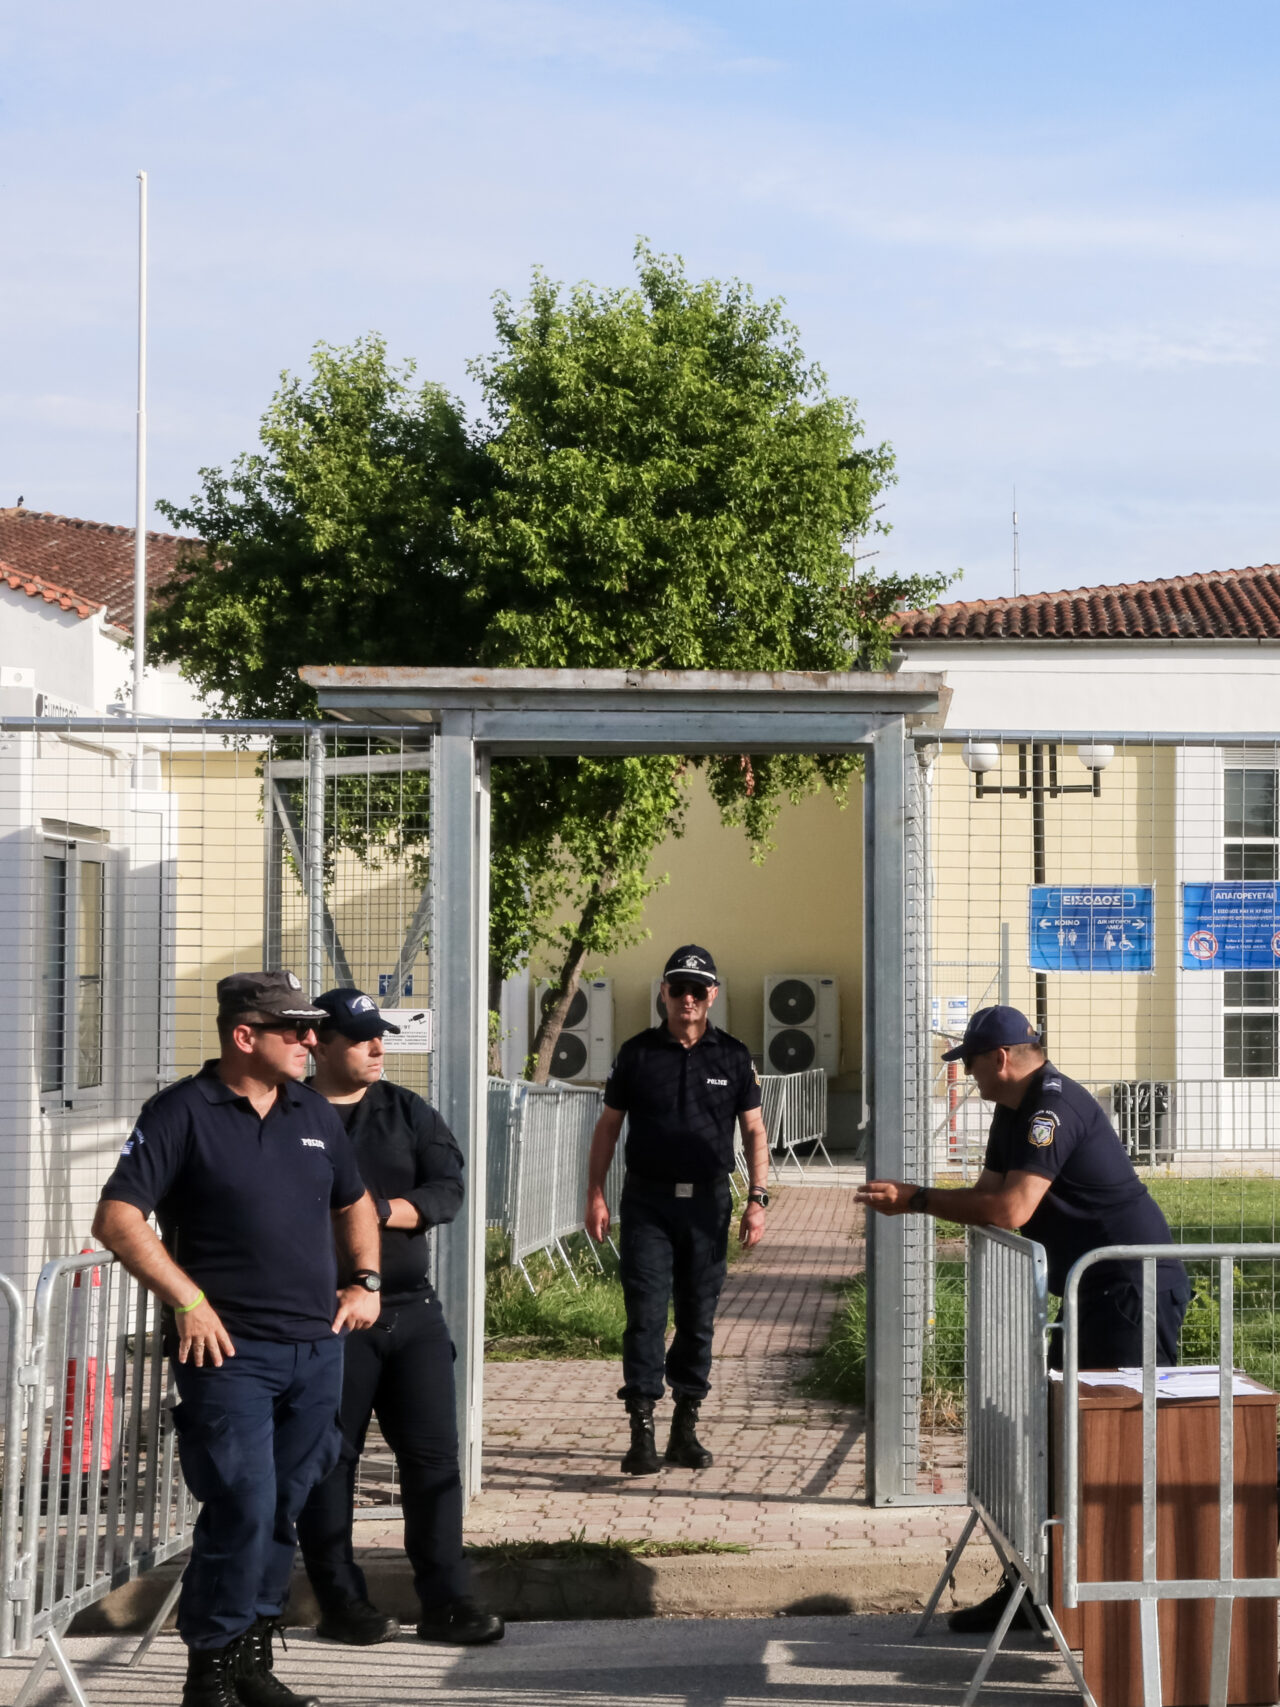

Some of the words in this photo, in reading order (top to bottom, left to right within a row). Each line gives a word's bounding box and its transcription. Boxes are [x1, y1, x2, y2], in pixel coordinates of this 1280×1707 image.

[1215, 892, 1274, 900] ΑΠΑΓΟΡΕΥΕΤΑΙ
[1062, 895, 1121, 906] ΕΙΣΟΔΟΣ
[706, 1078, 728, 1086] POLICE
